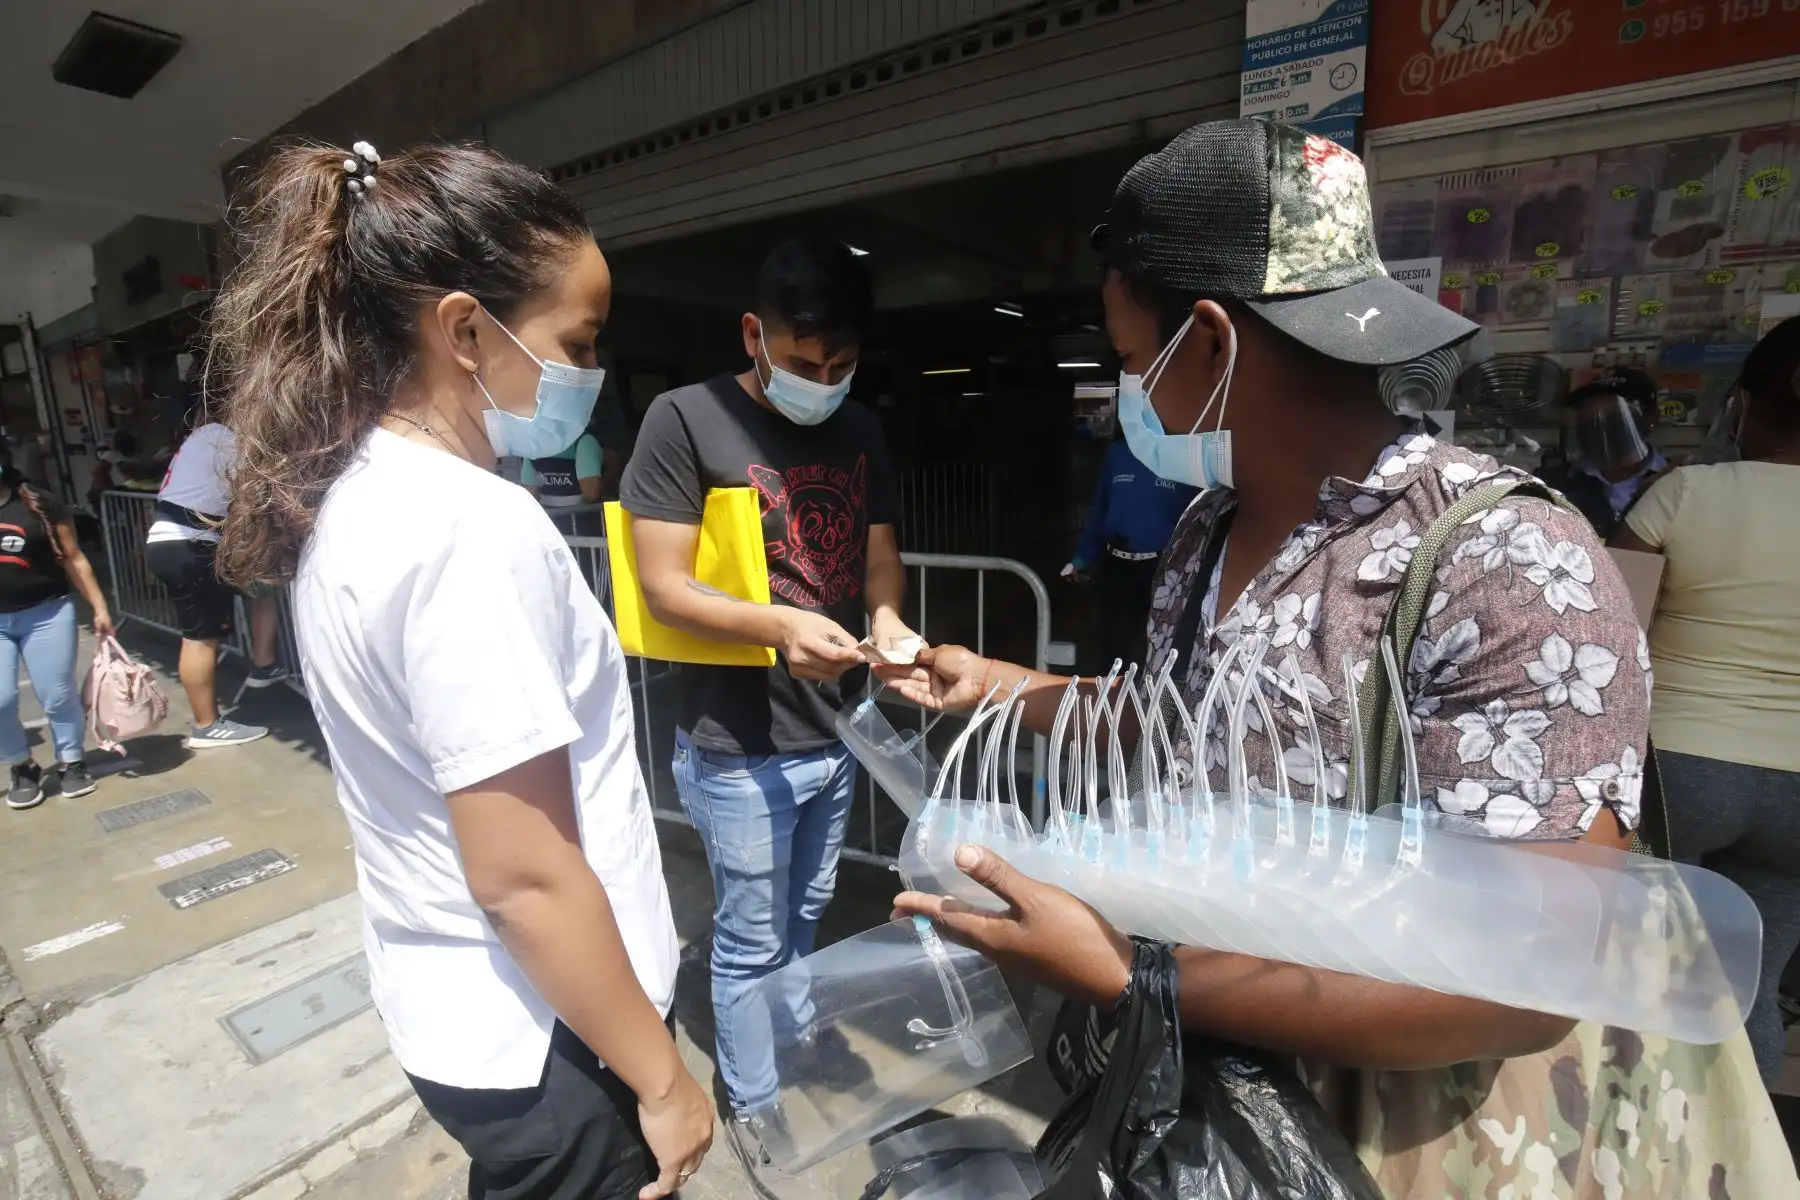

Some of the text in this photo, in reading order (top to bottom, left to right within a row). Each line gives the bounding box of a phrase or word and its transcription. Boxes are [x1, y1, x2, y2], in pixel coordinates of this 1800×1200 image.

[1653, 6, 1705, 37] 955
[1247, 15, 1362, 51] HORARIO DE ATENCION
[1251, 46, 1292, 61] PUBLICO
[1294, 41, 1308, 52] EN
[1244, 69, 1273, 82] LUNES
[1244, 90, 1291, 106] DOMINGO
[1390, 268, 1432, 281] NECESITA
[544, 476, 574, 487] LIMA
